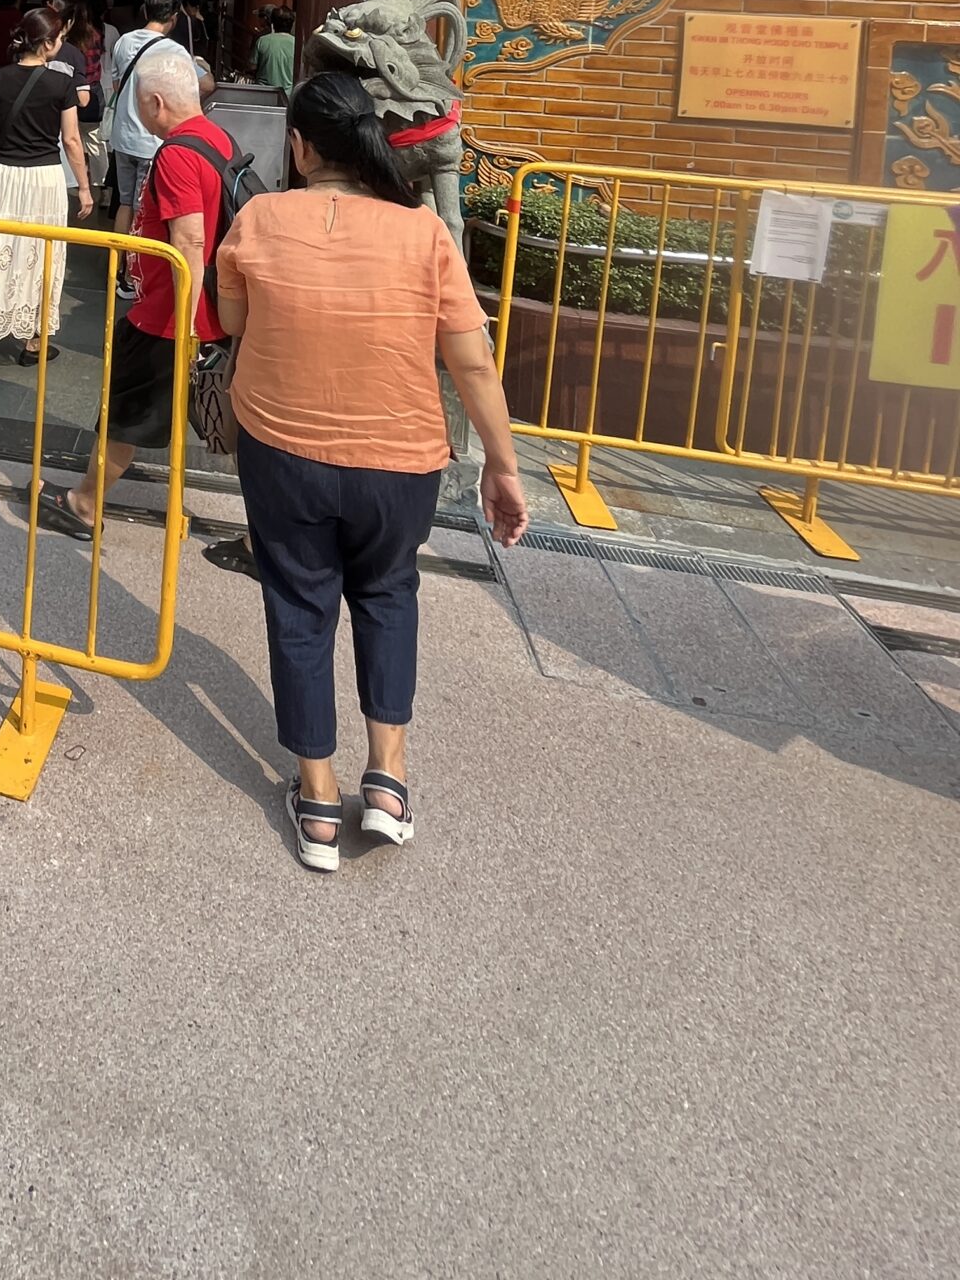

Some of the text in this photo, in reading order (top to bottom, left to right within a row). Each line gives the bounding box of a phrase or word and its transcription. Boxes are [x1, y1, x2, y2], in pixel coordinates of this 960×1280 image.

[731, 37, 761, 46] THONG
[814, 41, 849, 51] TEMPLE
[725, 88, 809, 101] OPENING HOURS
[745, 102, 756, 111] to
[802, 106, 830, 117] Daily
